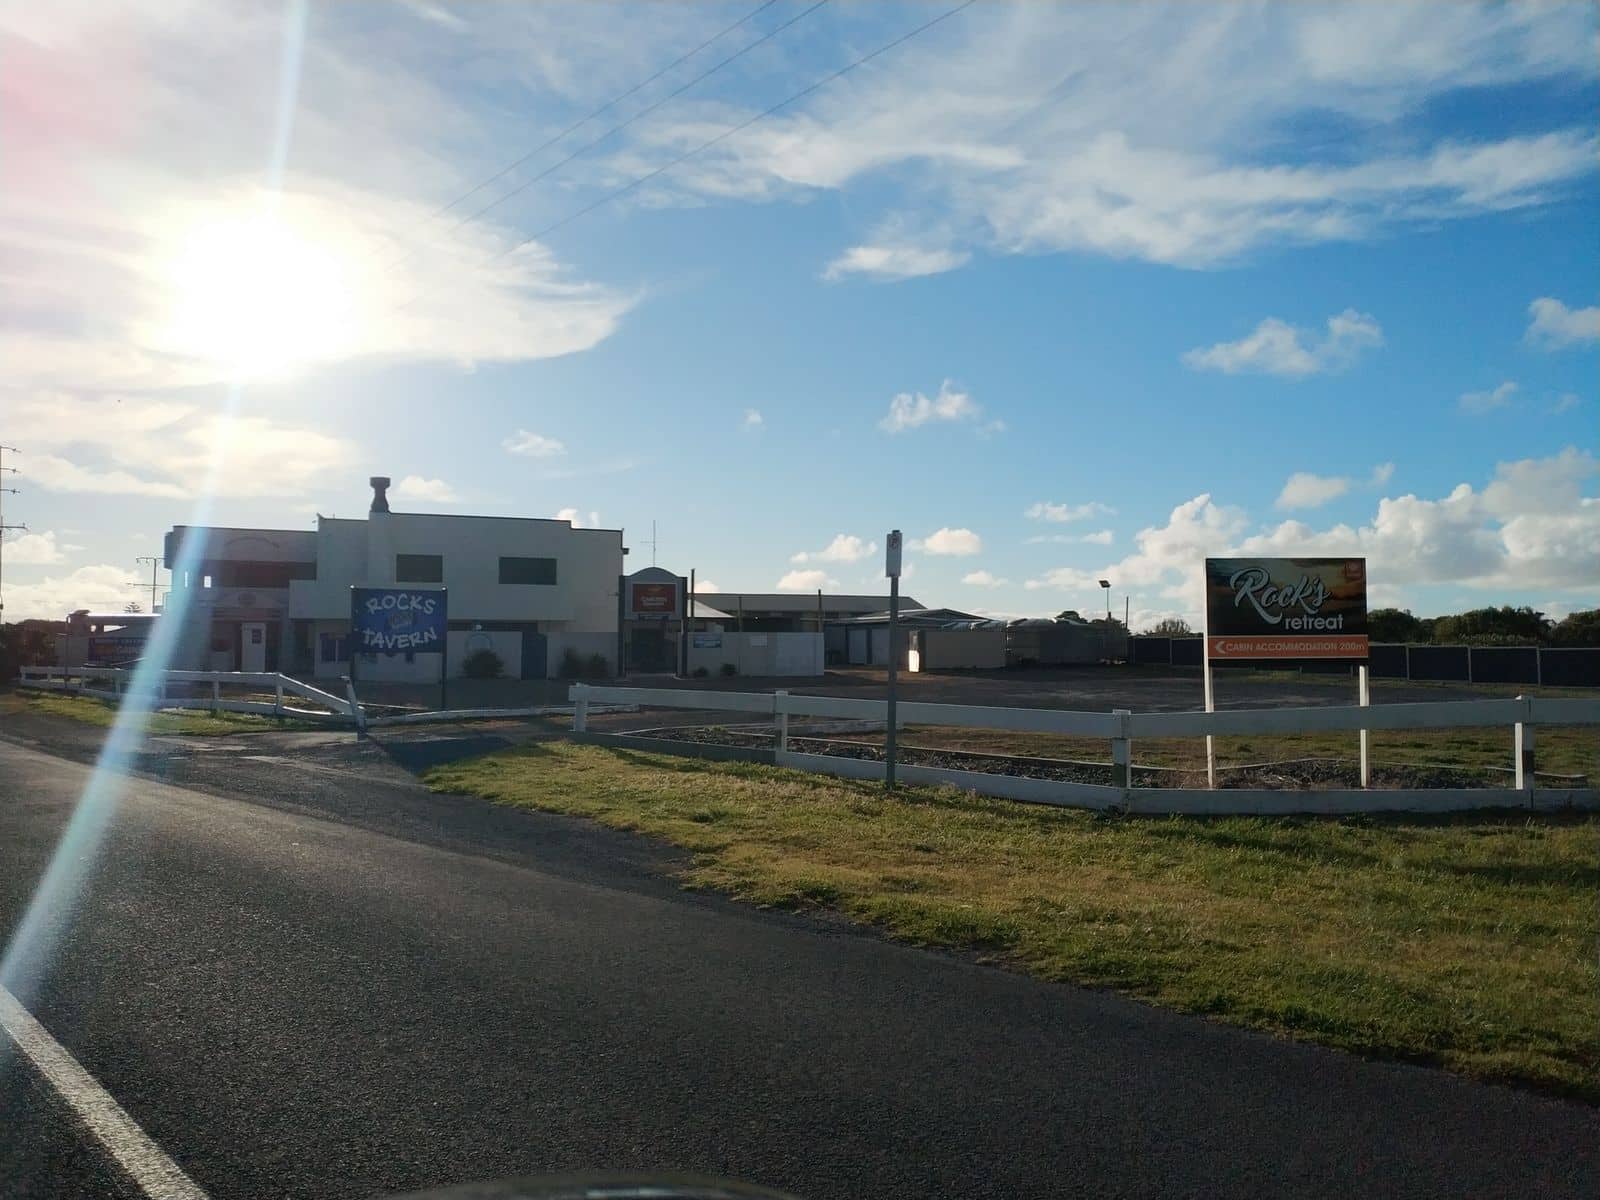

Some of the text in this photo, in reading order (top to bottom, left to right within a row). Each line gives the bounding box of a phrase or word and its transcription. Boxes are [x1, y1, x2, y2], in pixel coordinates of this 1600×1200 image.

[365, 593, 436, 615] ROCKS
[1230, 567, 1331, 624] Rock's
[1285, 614, 1344, 631] retreat
[362, 627, 438, 649] TAVERN
[1226, 640, 1365, 653] CABIN ACCOMMODATION 200m
